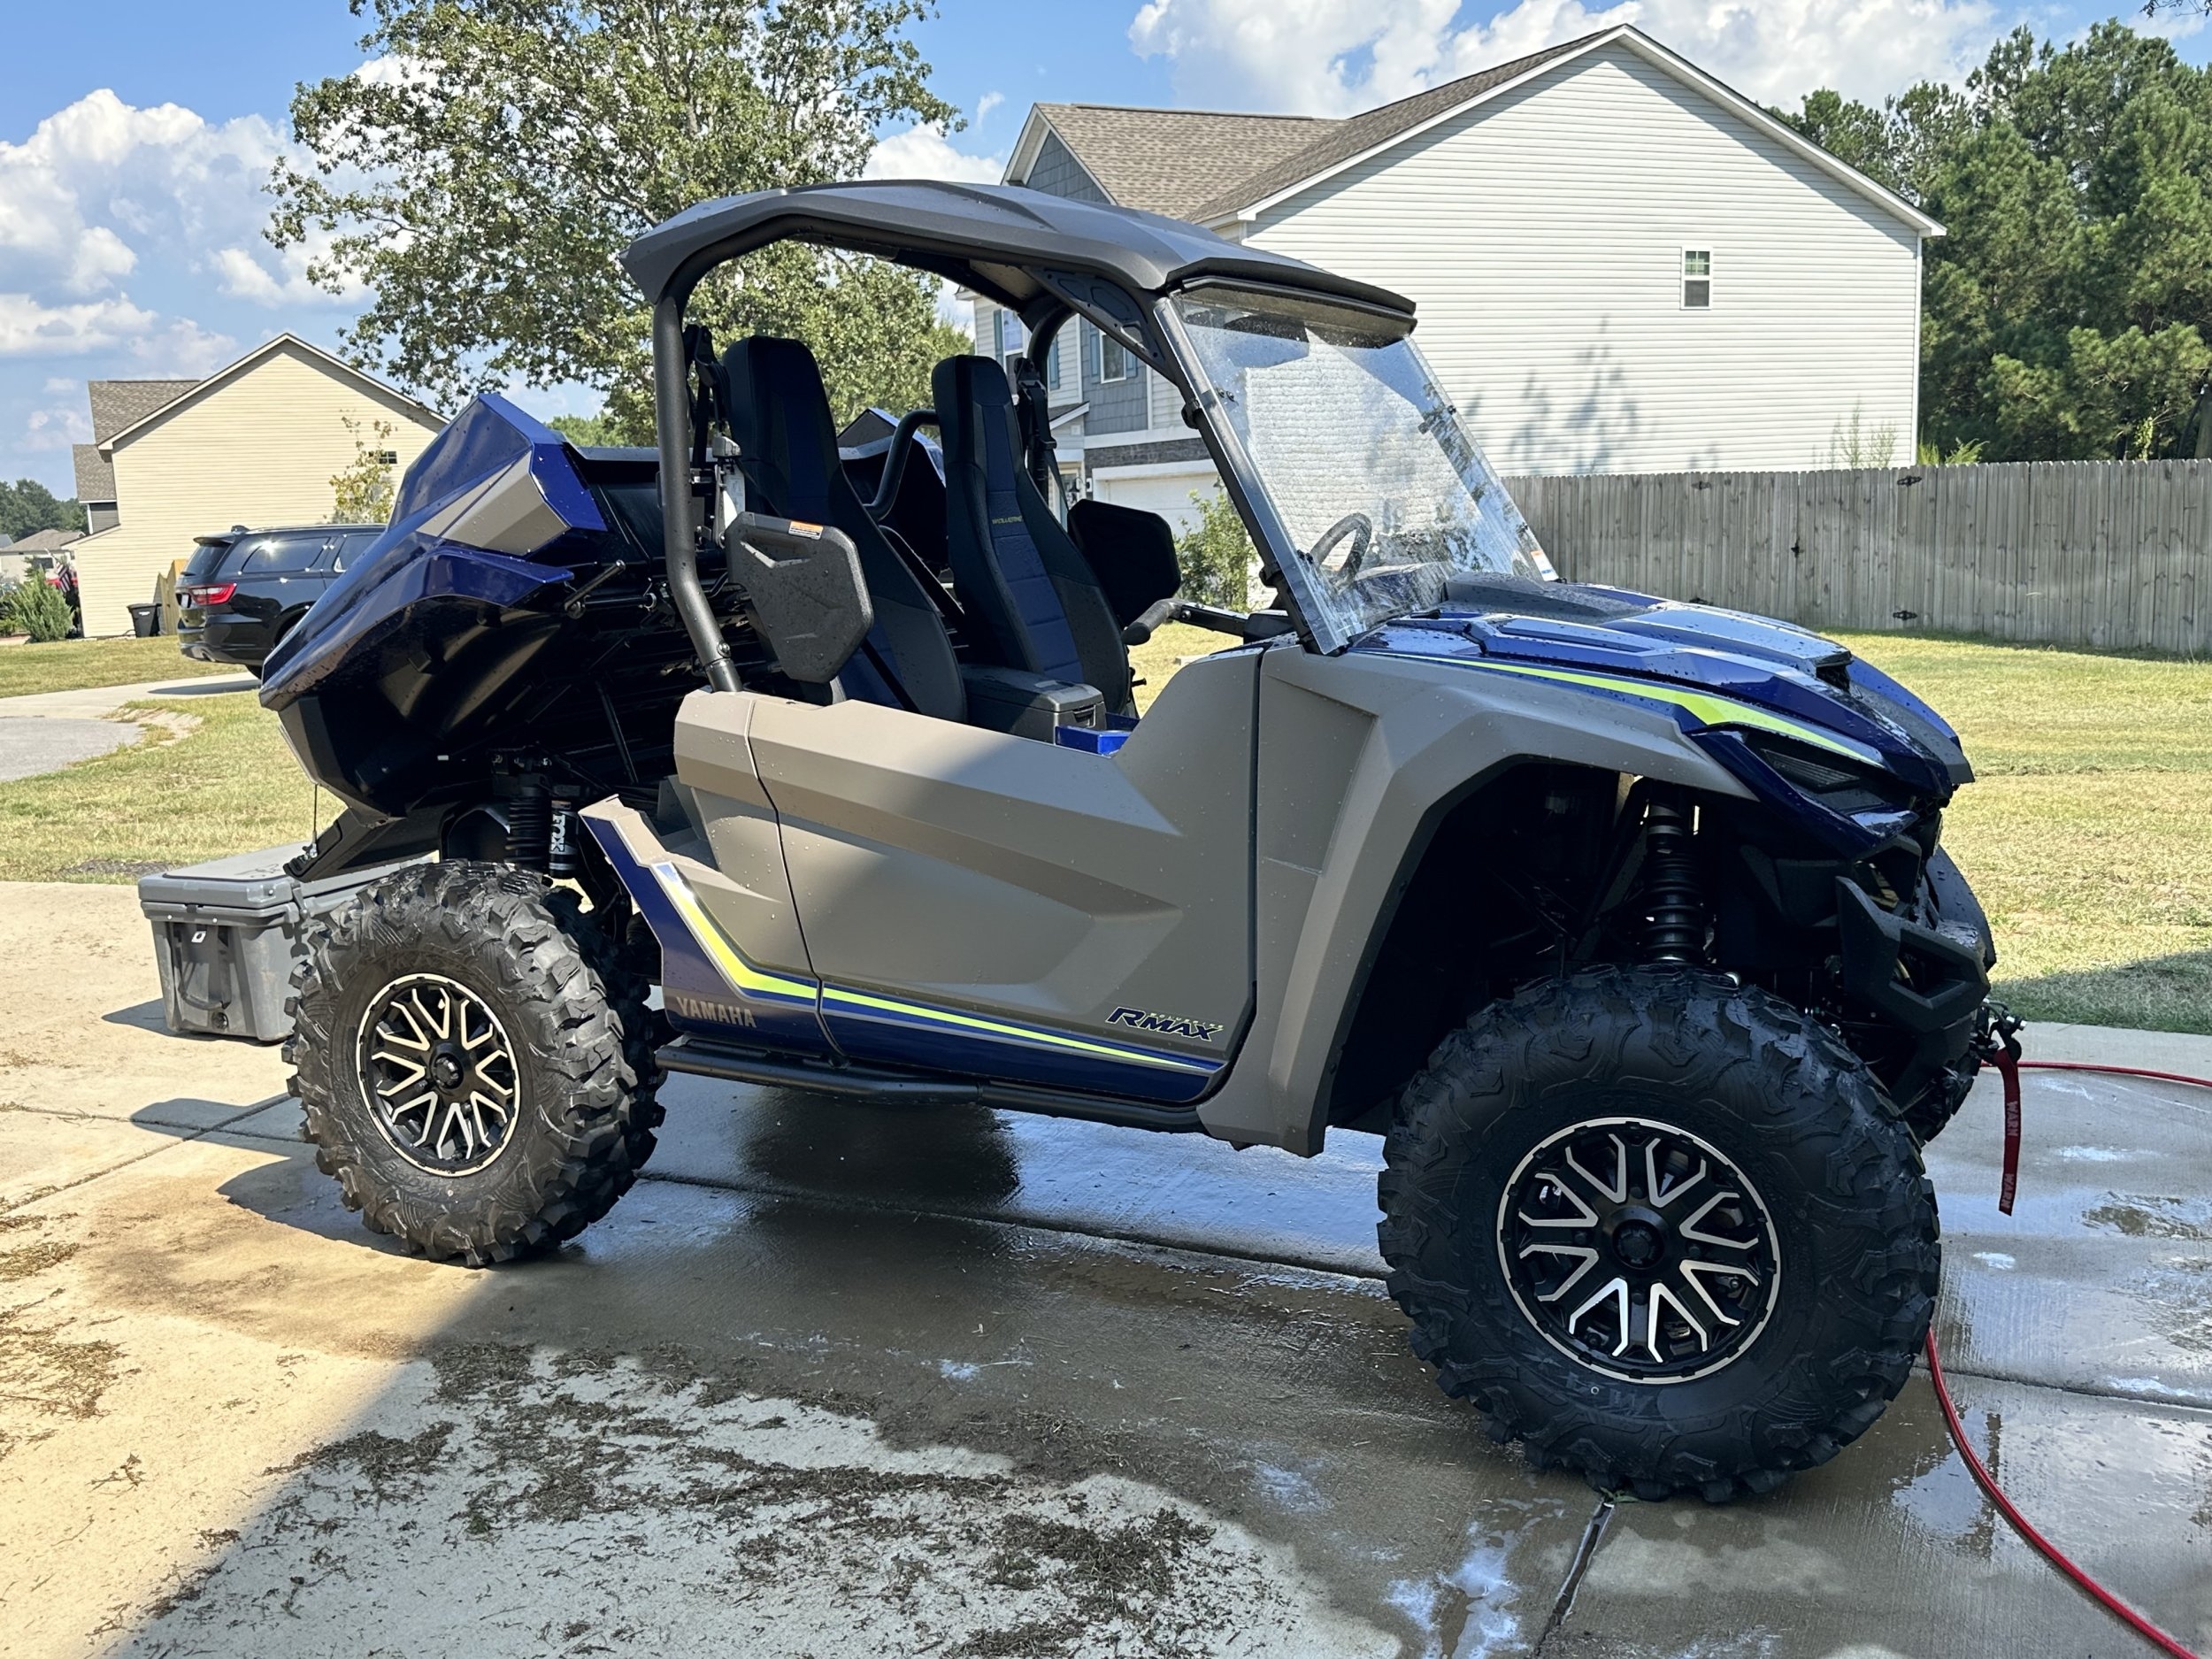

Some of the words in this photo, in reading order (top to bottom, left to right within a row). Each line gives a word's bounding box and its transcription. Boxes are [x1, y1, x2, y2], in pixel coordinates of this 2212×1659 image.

[551, 814, 565, 850] FOX
[675, 996, 757, 1028] YAMAHA
[1105, 1006, 1223, 1041] RMAX
[2006, 1101, 2018, 1137] WARN
[2001, 1173, 2015, 1209] WARN
